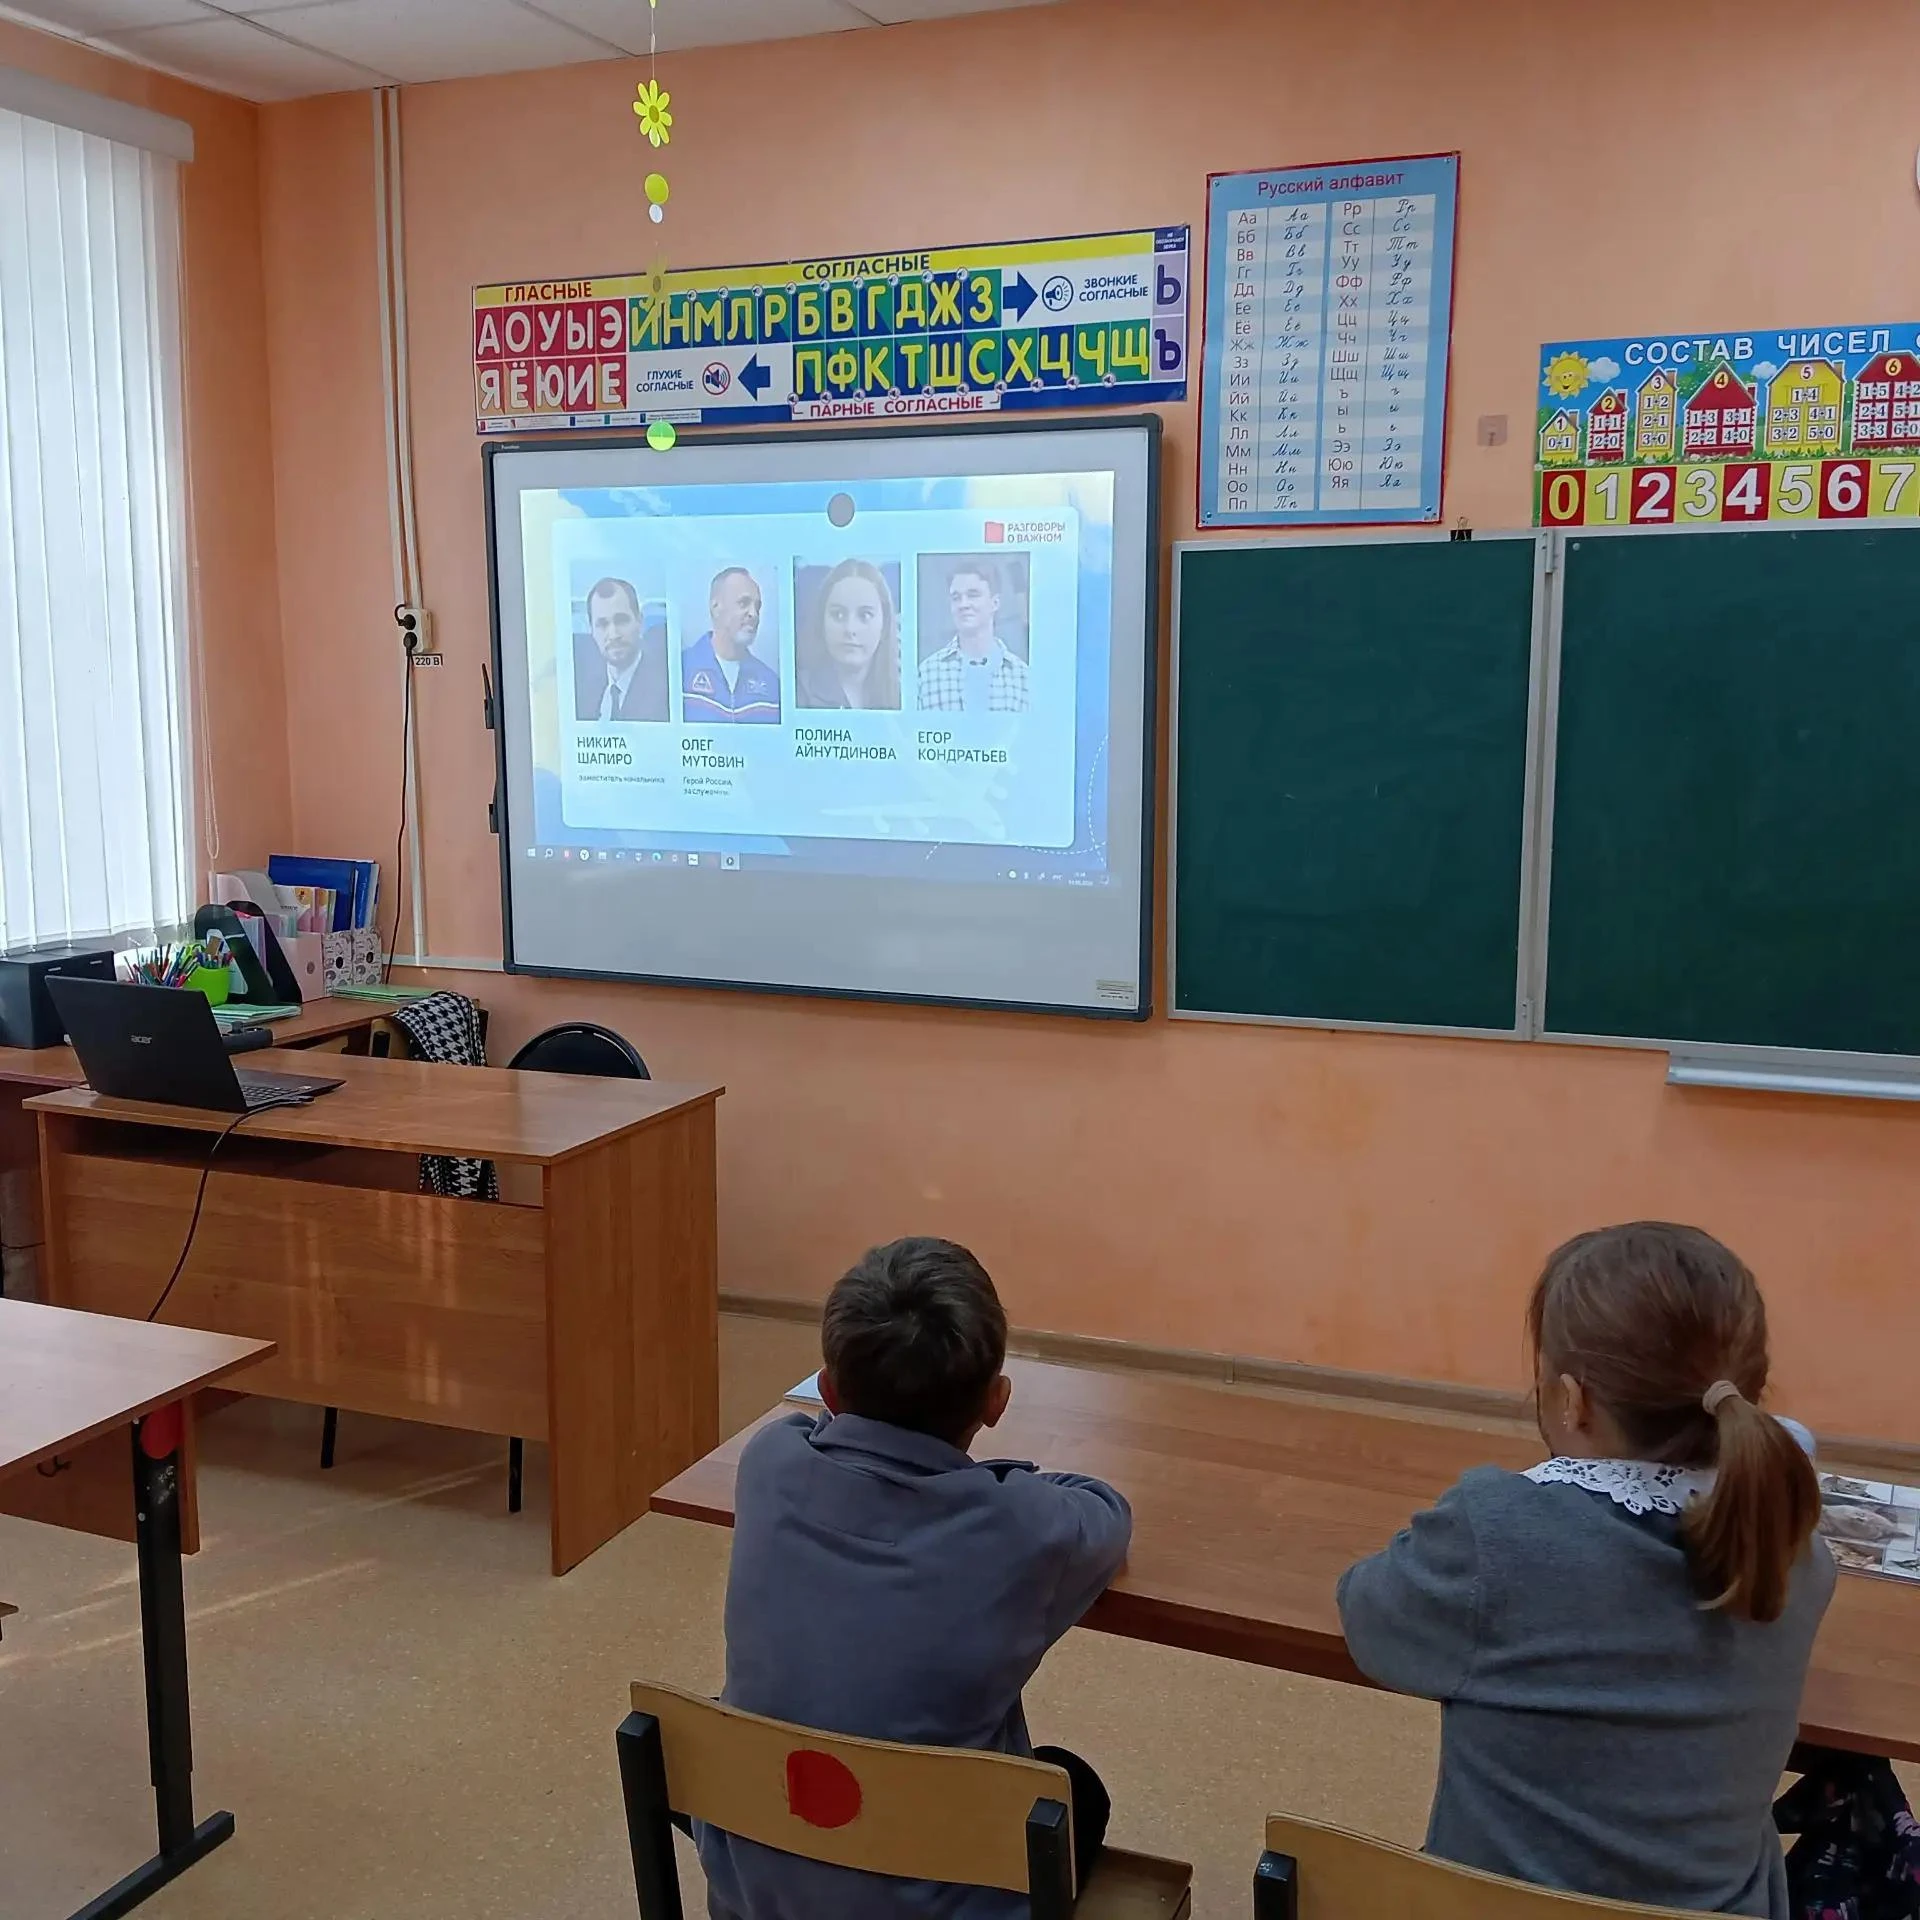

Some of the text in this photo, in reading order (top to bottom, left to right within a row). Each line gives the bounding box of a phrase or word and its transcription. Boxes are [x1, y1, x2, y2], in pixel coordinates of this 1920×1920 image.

[1258, 173, 1404, 198] Русский алфавит
[1344, 203, 1361, 219] Рр
[1238, 212, 1256, 225] Аа
[1343, 222, 1360, 235] Сс
[1238, 230, 1255, 244] Бб
[1344, 241, 1358, 253] Тт
[1238, 248, 1253, 261] Вв
[802, 255, 930, 280] СОГЛАСНЫЕ
[1342, 256, 1359, 271] Уу
[1238, 266, 1251, 279] Гг
[1084, 274, 1137, 288] ЗВОНКИЕ
[1336, 275, 1362, 290] Фф
[505, 281, 592, 302] ГЛАСНЫЕ
[1079, 286, 1149, 302] СОГЛАСНЫЕ
[1234, 283, 1254, 298] Дд
[1339, 295, 1357, 308] Хх
[1236, 302, 1250, 315] Ее
[1338, 314, 1357, 327] Цц
[1231, 339, 1254, 350] Жж
[1338, 333, 1356, 344] Чч
[1624, 337, 1753, 365] СОСТАВ
[1777, 330, 1890, 358] ЧИСЕЛ
[1333, 350, 1359, 362] Шш
[1234, 357, 1248, 368] Зз
[1889, 360, 1898, 373] 6
[647, 369, 682, 380] ГЛУХИЕ
[1331, 368, 1357, 381] Щщ
[1803, 367, 1811, 379] 5
[1231, 374, 1250, 386] Ии
[1654, 376, 1661, 388] 3
[1716, 375, 1725, 386] 4
[636, 380, 694, 393] СОГЛАСНЫЕ
[1230, 392, 1249, 404] Йй
[1605, 398, 1612, 409] 2
[811, 397, 983, 417] ПАРНЫЕ СОГЛАСНЫЕ
[1231, 409, 1247, 421] Кк
[1557, 418, 1562, 431] 1
[1230, 427, 1248, 440] Лл
[1226, 446, 1250, 457] Мм
[1333, 440, 1350, 452] Ээ
[1229, 463, 1247, 475] Нн
[1329, 458, 1353, 470] Юю
[1228, 480, 1247, 492] Оо
[1332, 476, 1349, 488] Яя
[1549, 463, 1915, 520] 0 1 2 3 4 5 6 7
[1229, 498, 1247, 510] Пп
[1008, 522, 1065, 532] РАЗГОВОРЫ
[1008, 534, 1061, 543] О ВАЖНОМ
[416, 657, 430, 666] 220
[795, 729, 852, 742] ПОЛИНА
[918, 732, 951, 744] ЕГОР
[577, 737, 626, 749] НИКИТА
[682, 739, 714, 751] ОЛЕГ
[795, 744, 896, 760] АЙНУТДИНОВА
[918, 749, 1007, 763] КОНДРАТЬЕВ
[577, 753, 632, 765] ШАПИРО
[682, 756, 744, 768] МУТОВИН
[683, 777, 703, 785] Герой
[130, 1034, 152, 1044] acer
